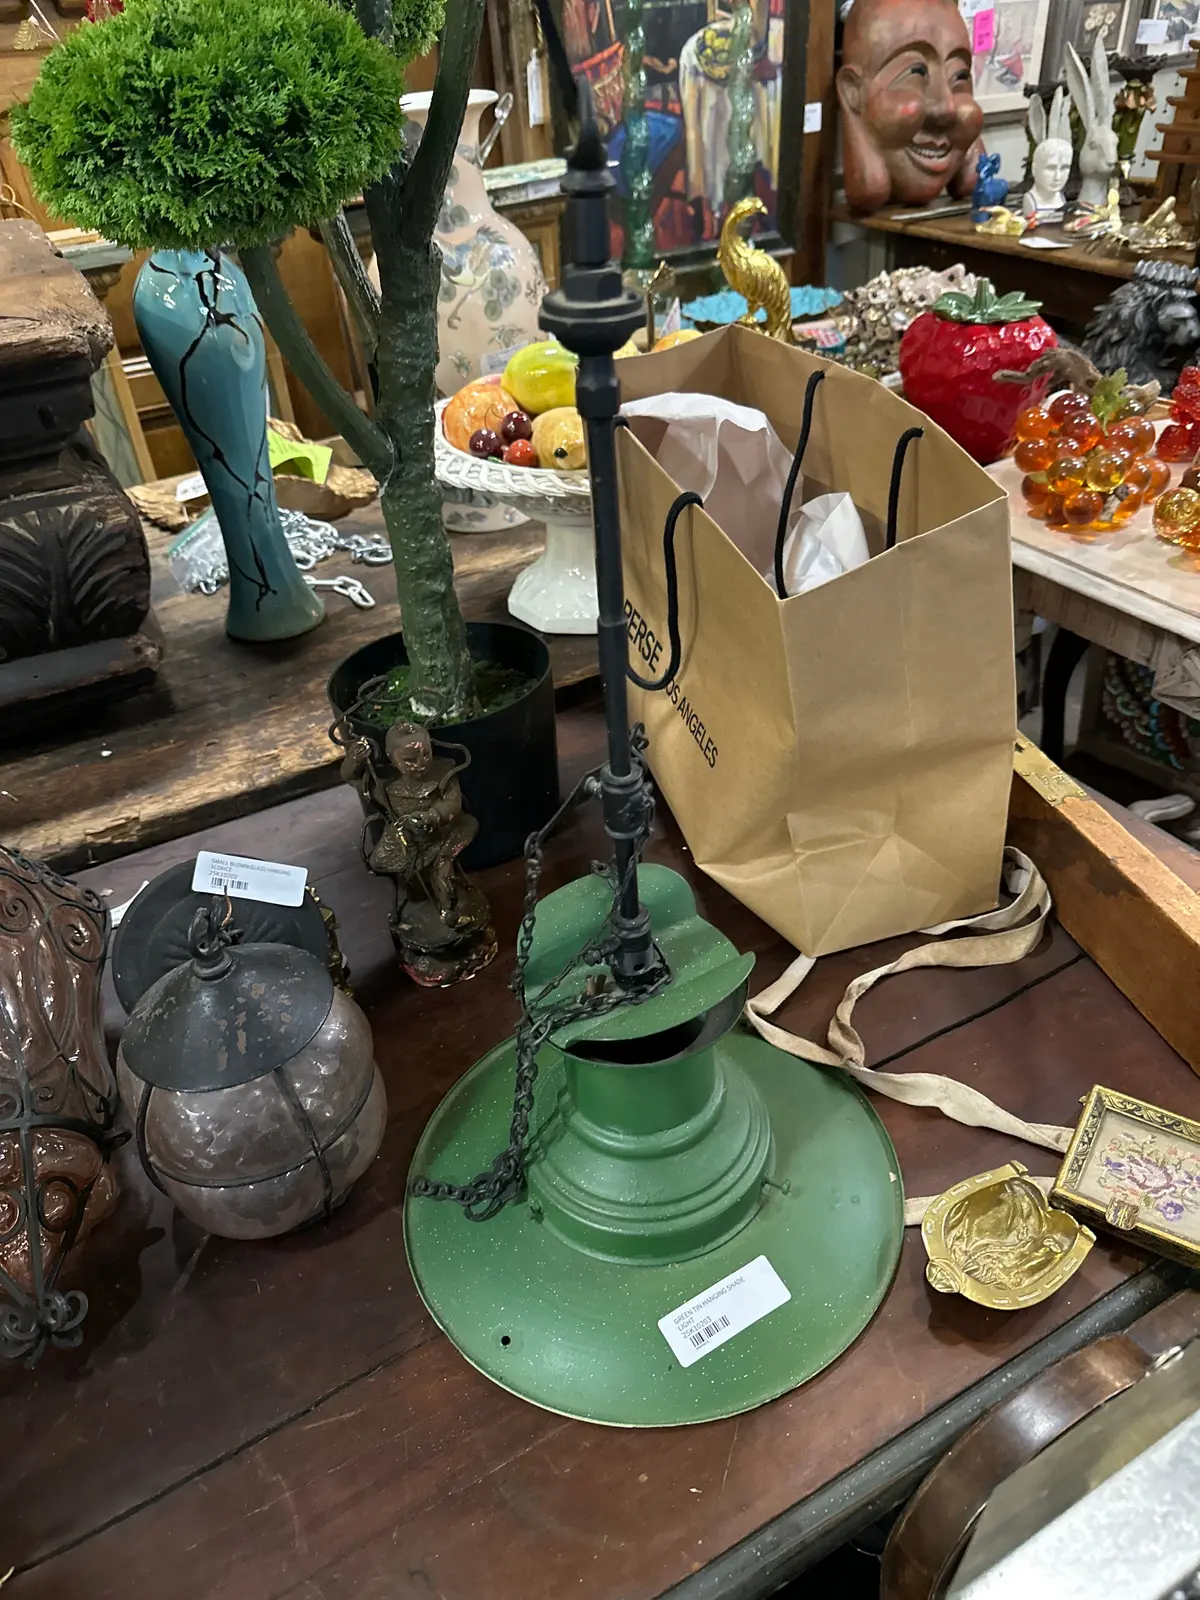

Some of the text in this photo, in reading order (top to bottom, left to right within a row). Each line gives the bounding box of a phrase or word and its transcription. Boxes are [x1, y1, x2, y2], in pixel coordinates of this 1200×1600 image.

[677, 697, 719, 769] ANGELES
[211, 858, 229, 867] SMALL
[673, 1276, 745, 1325] GREEN TIN HANGING SHADE
[677, 1317, 695, 1332] LIGHT
[681, 1316, 712, 1339] 25K10203
